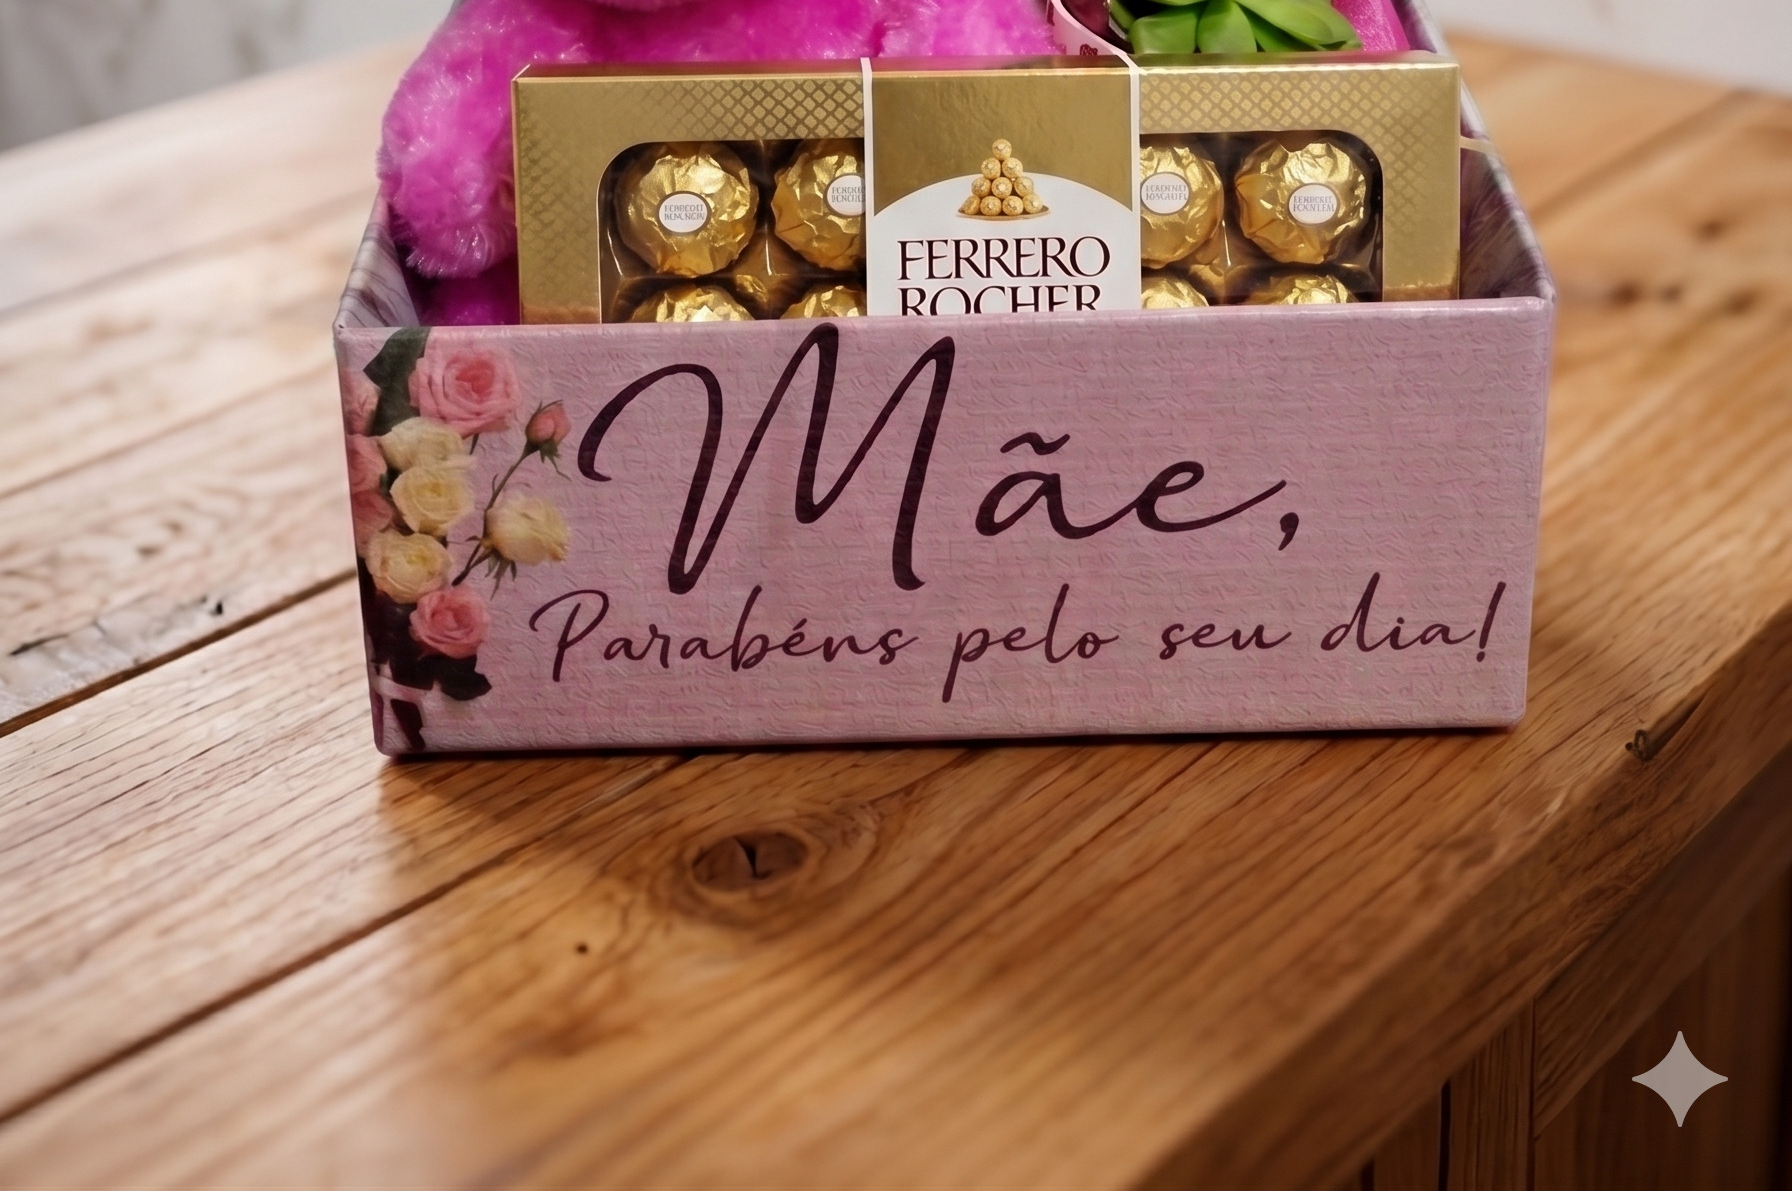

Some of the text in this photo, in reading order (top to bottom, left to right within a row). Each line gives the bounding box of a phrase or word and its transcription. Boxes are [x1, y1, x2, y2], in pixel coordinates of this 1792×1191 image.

[897, 236, 1111, 280] FERRERO
[577, 322, 1300, 595] Mãe,
[528, 572, 1507, 704] Parabéns pelo seu dia!
